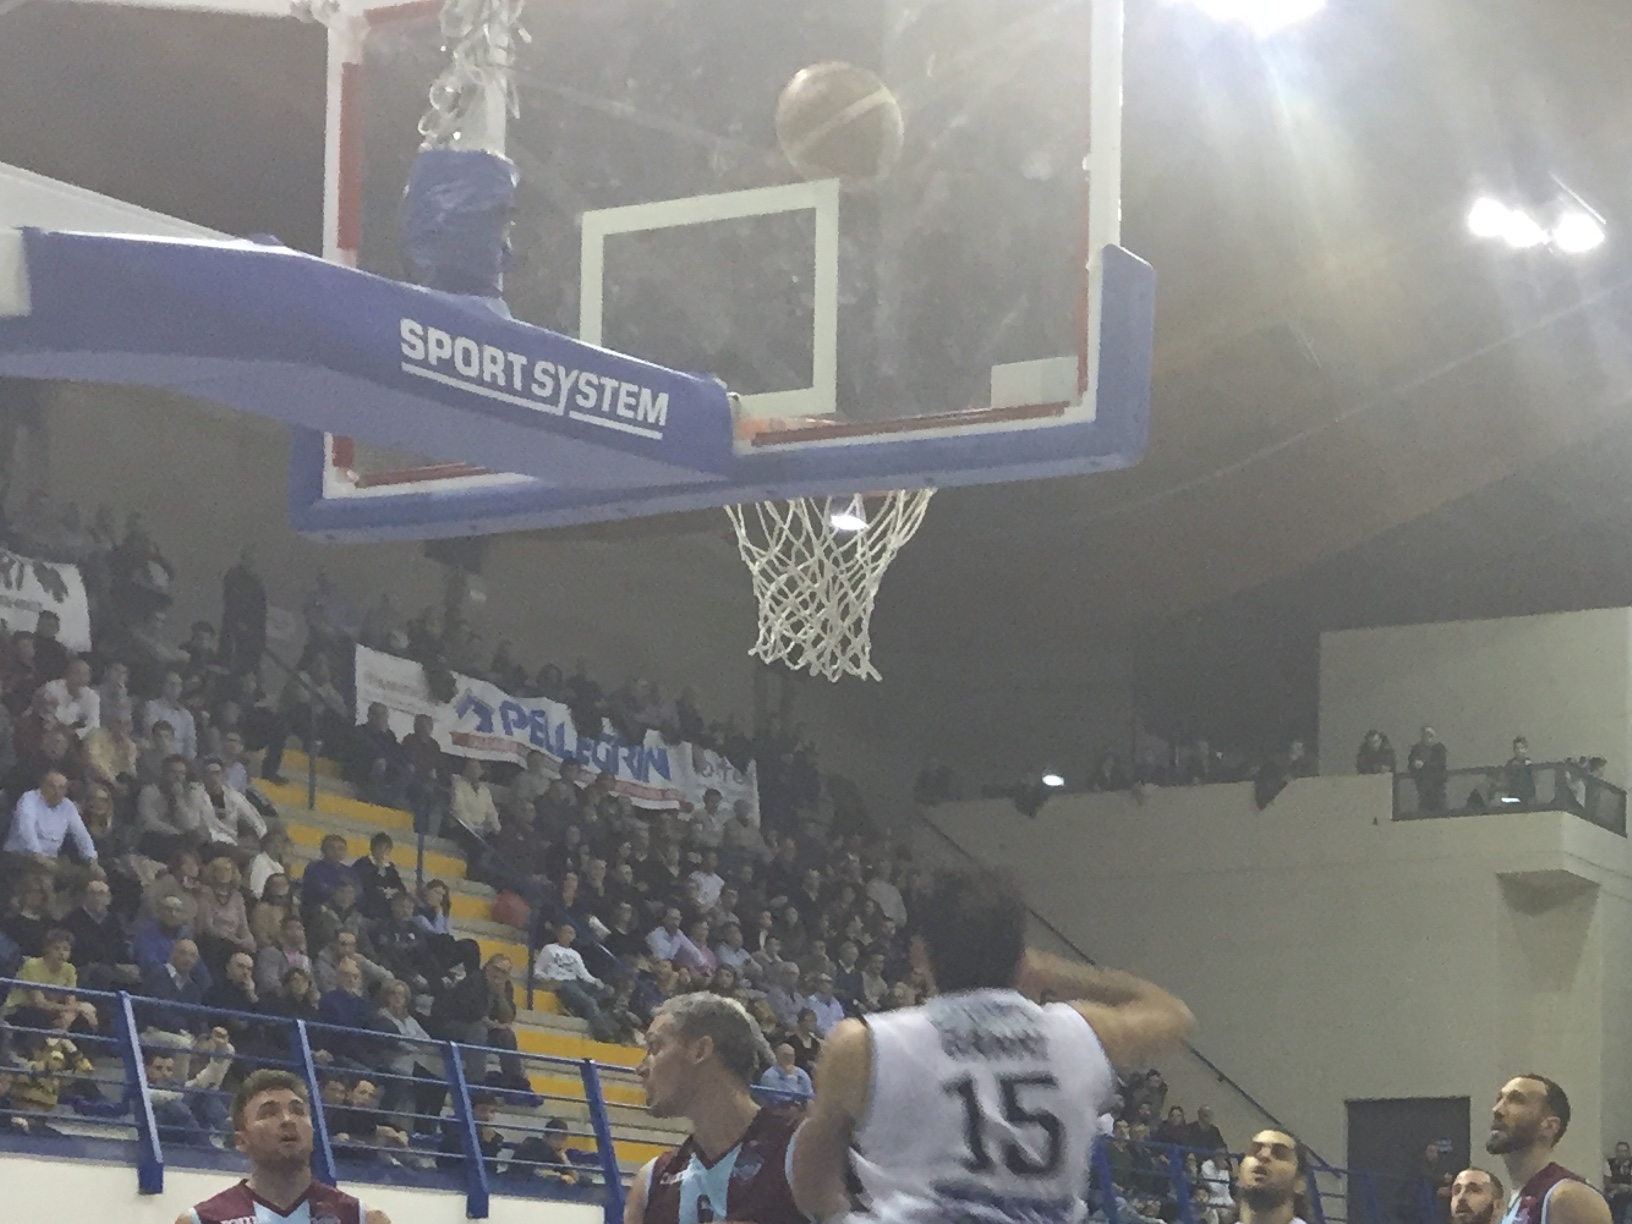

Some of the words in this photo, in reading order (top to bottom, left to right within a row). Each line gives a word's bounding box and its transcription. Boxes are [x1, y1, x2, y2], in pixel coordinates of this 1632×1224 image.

[400, 318, 527, 392] SPORT
[530, 360, 670, 426] SYSTEM
[941, 1072, 1067, 1178] 15
